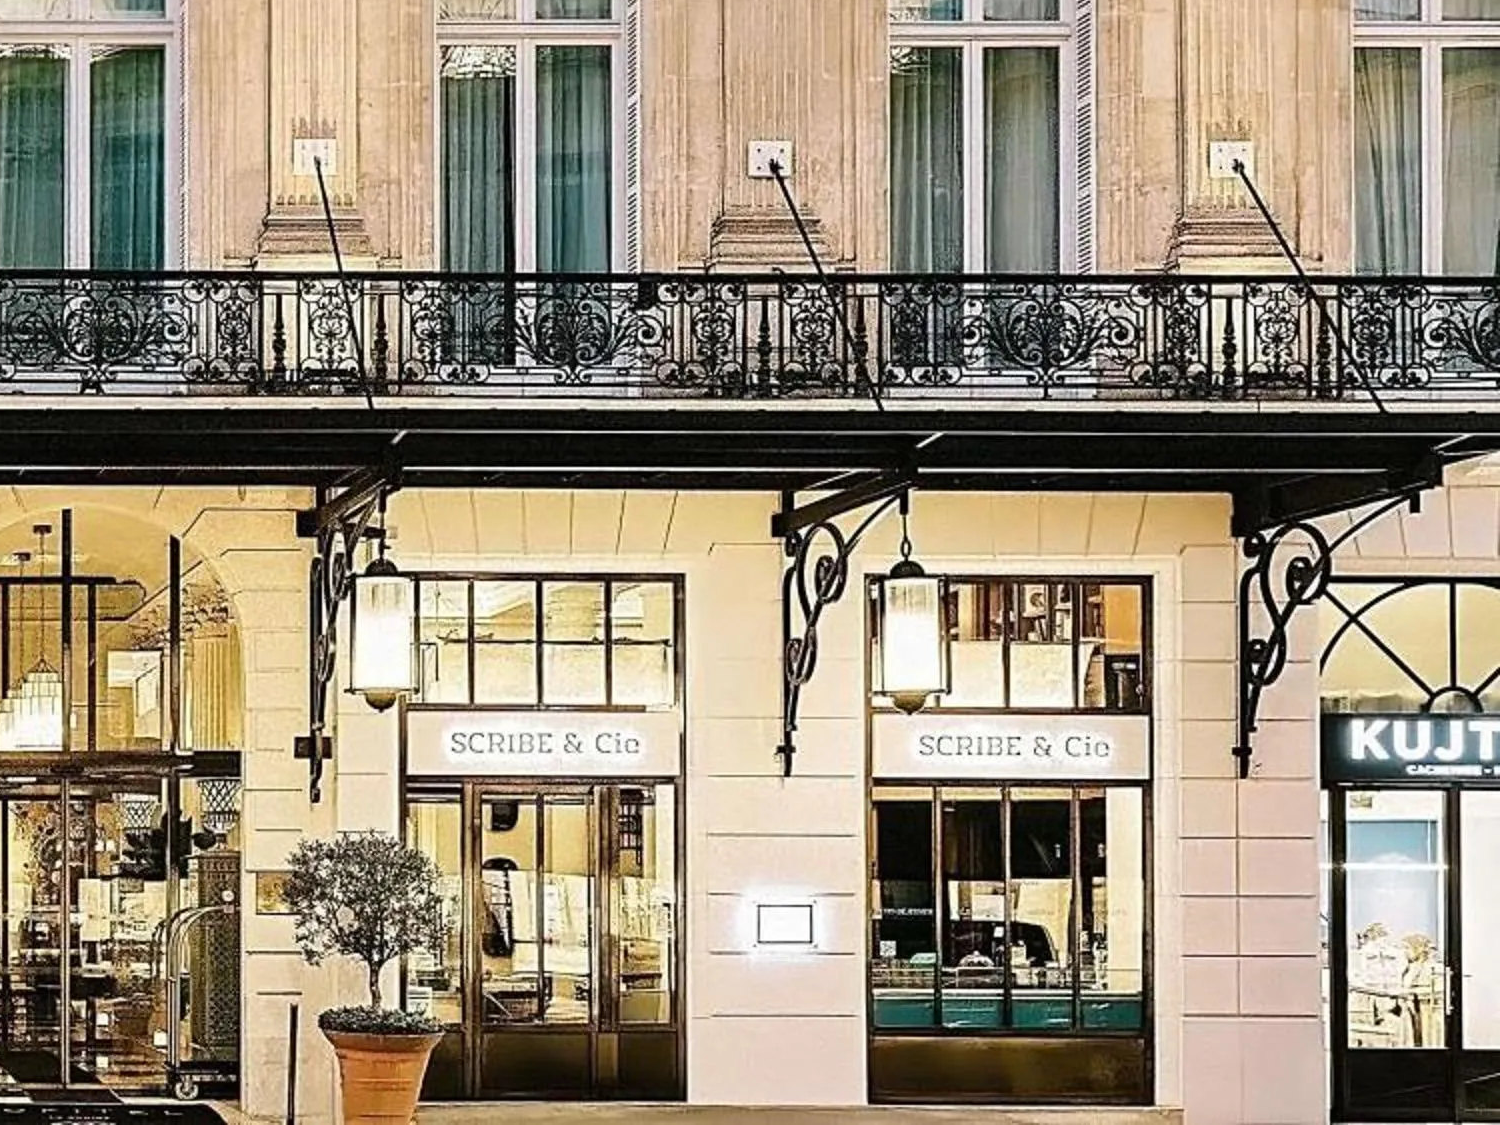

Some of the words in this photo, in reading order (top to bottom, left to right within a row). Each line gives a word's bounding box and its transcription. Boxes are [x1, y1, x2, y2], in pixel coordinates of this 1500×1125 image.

[451, 732, 553, 754] SCRIBE
[563, 732, 583, 754] &
[595, 732, 640, 754] Cie
[918, 735, 1022, 757] SCRIBE
[1032, 735, 1053, 757] &
[1065, 735, 1111, 757] Cie
[1351, 719, 1500, 760] KUJT
